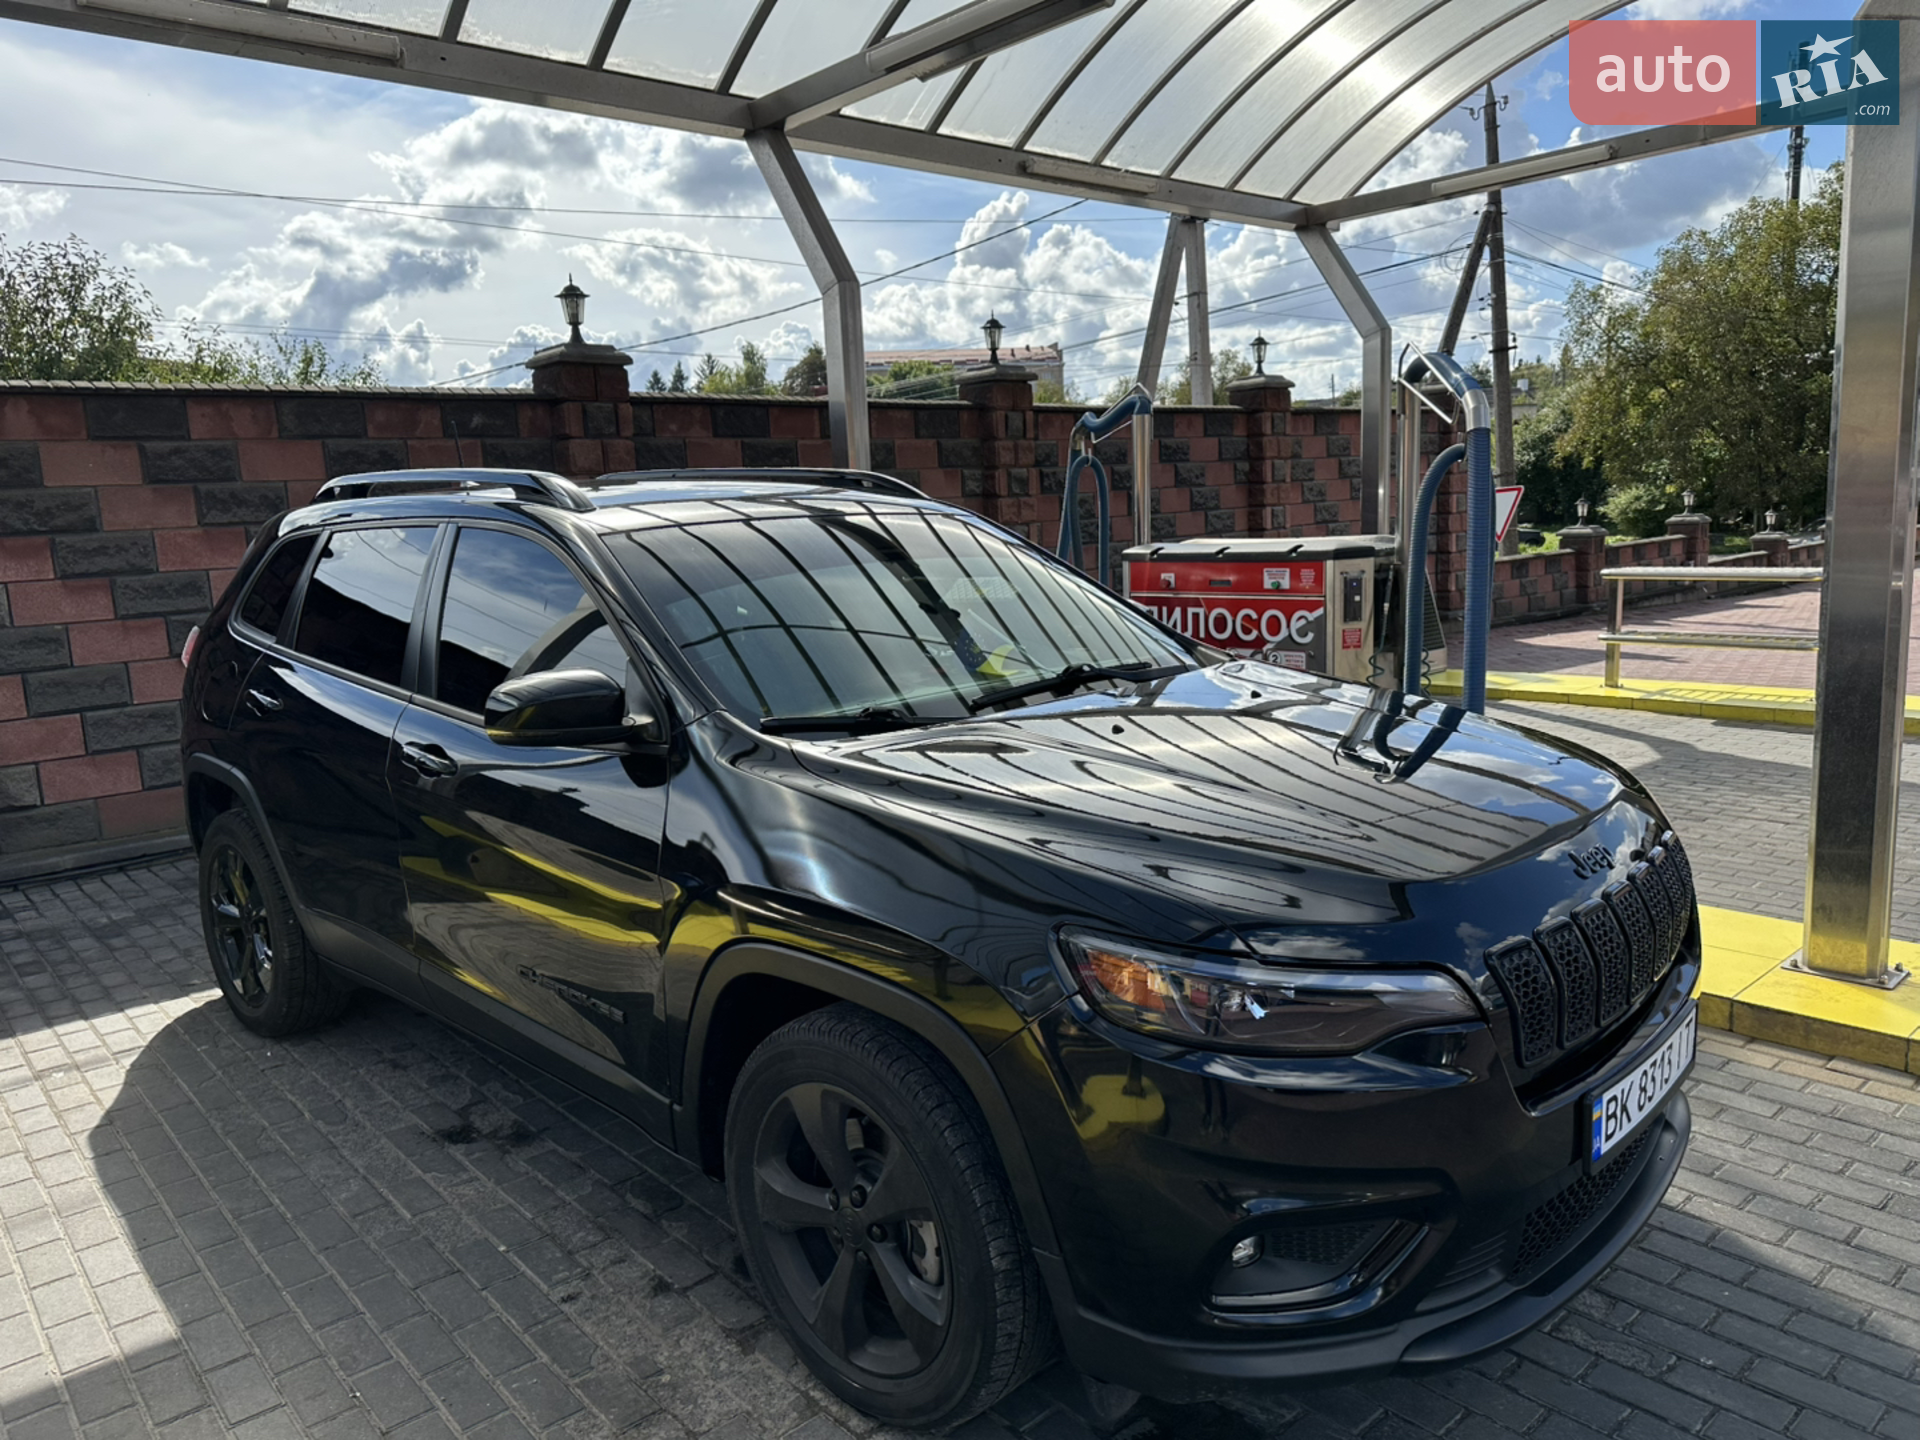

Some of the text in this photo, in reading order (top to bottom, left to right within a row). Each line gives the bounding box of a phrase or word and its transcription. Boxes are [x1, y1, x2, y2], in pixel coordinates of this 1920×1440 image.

[1271, 654, 1279, 664] 2
[1567, 843, 1616, 880] Jeep
[1604, 1017, 1694, 1143] BK 8313 IT
